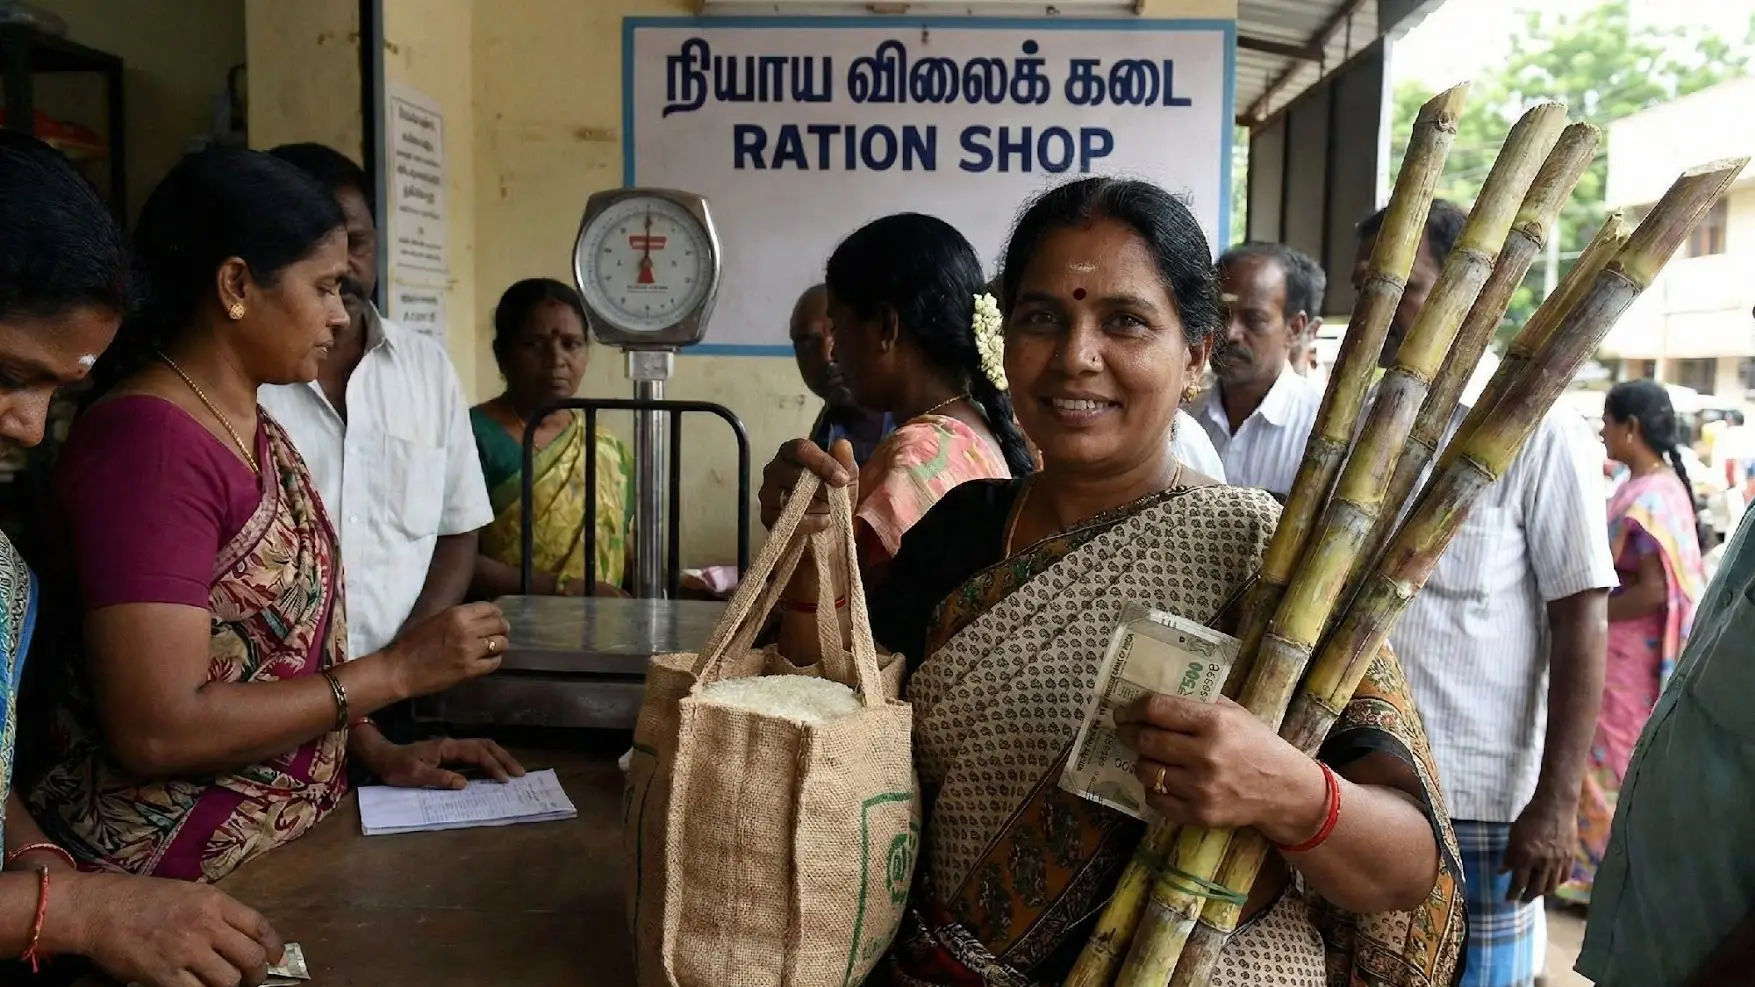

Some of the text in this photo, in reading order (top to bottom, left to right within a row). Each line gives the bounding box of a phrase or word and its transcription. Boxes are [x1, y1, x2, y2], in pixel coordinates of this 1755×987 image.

[662, 37, 1192, 119] நியாய விலைக் கடை
[733, 123, 1115, 174] RATION SHOP
